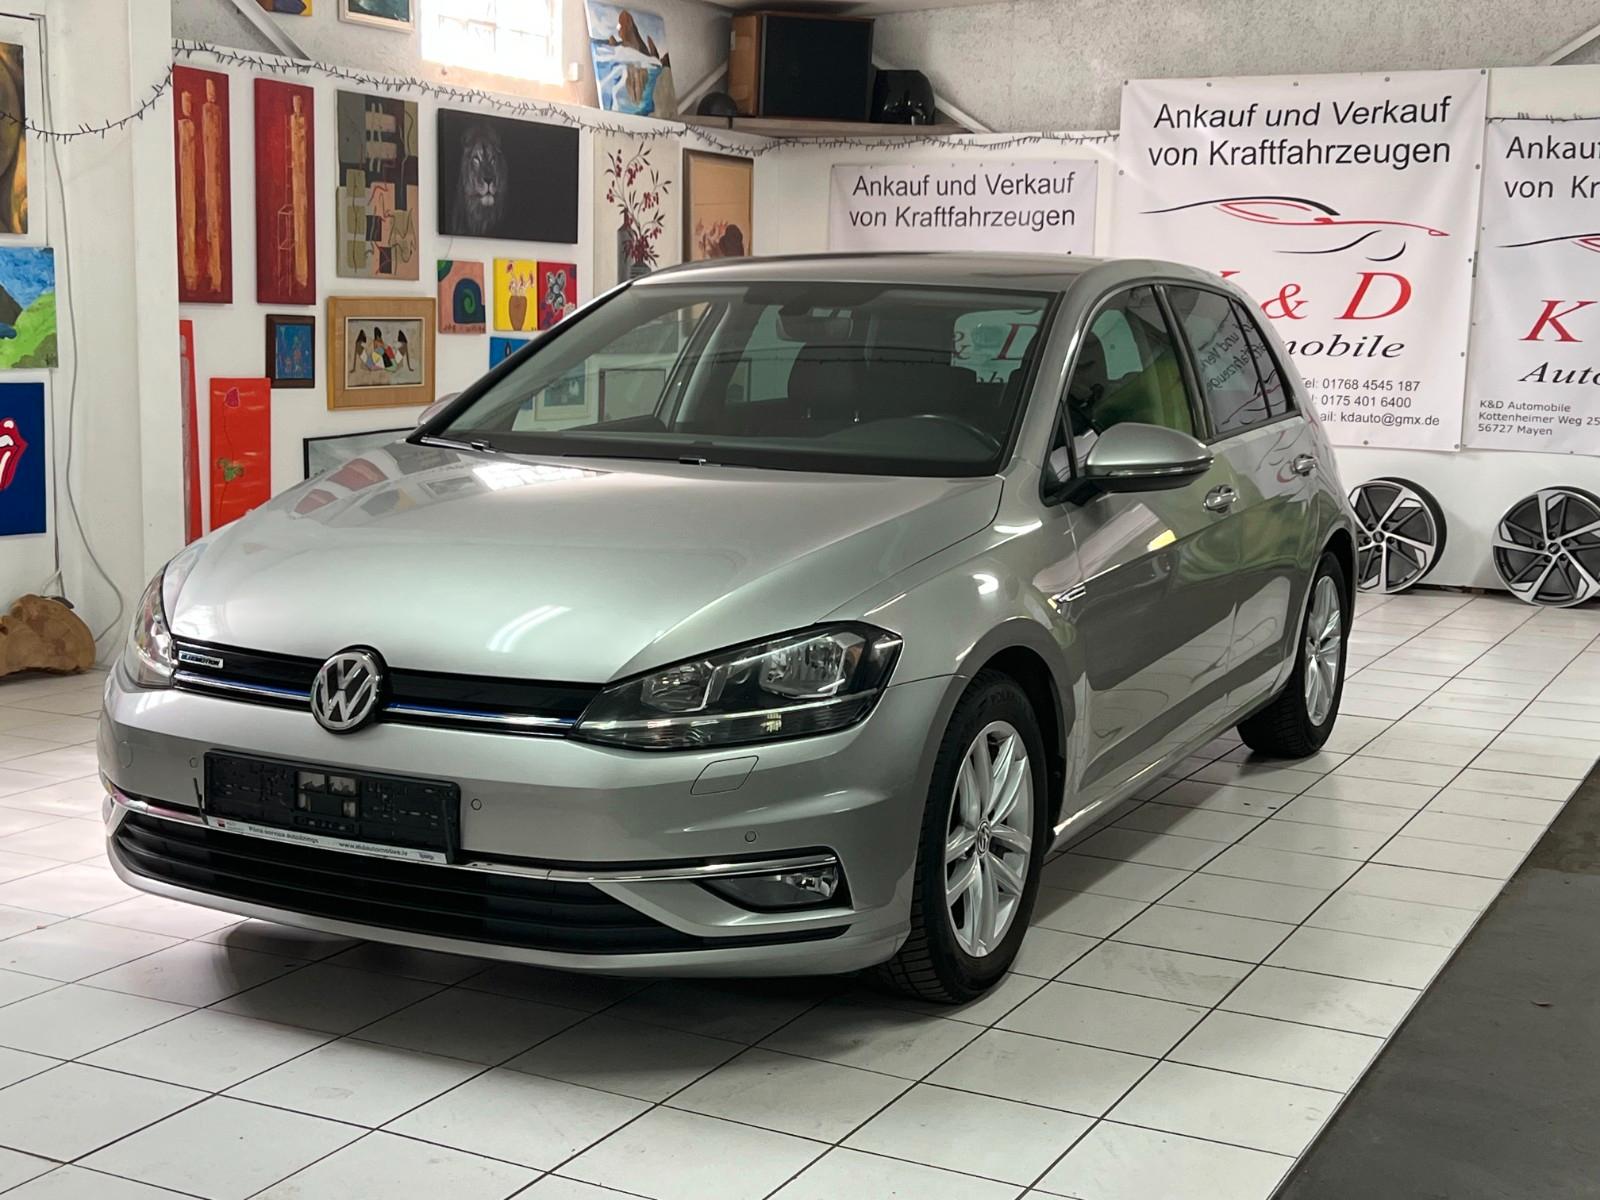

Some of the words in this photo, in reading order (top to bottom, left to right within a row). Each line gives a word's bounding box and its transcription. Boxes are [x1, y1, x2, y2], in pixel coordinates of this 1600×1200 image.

[1153, 102, 1259, 129] Ankauf
[1265, 101, 1321, 127] und
[1332, 95, 1452, 126] Verkauf
[1148, 146, 1198, 167] von
[1209, 138, 1450, 171] Kraftfahrzeugen
[851, 174, 930, 197] Ankauf
[936, 173, 976, 197] und
[984, 171, 1076, 196] Verkauf
[1504, 180, 1554, 199] von
[848, 210, 887, 227] von
[895, 205, 1075, 232] Kraftfahrzeugen
[1334, 271, 1412, 320] D
[1519, 299, 1598, 343] K
[1322, 377, 1359, 391] 01768
[1362, 379, 1393, 392] 4545
[1398, 380, 1421, 392] 187
[1320, 394, 1351, 407] 0175
[1354, 395, 1376, 408] 401
[1380, 396, 1412, 409] 6400
[1480, 400, 1504, 409] K&D
[1508, 401, 1571, 412] Automobile
[1319, 411, 1336, 423] ail:
[1340, 412, 1440, 427] kdauto@gmx.de
[1479, 411, 1554, 424] Kottenheimer
[1559, 416, 1582, 427] Weg
[1478, 423, 1513, 433] 56727
[1517, 425, 1553, 436] Mayen
